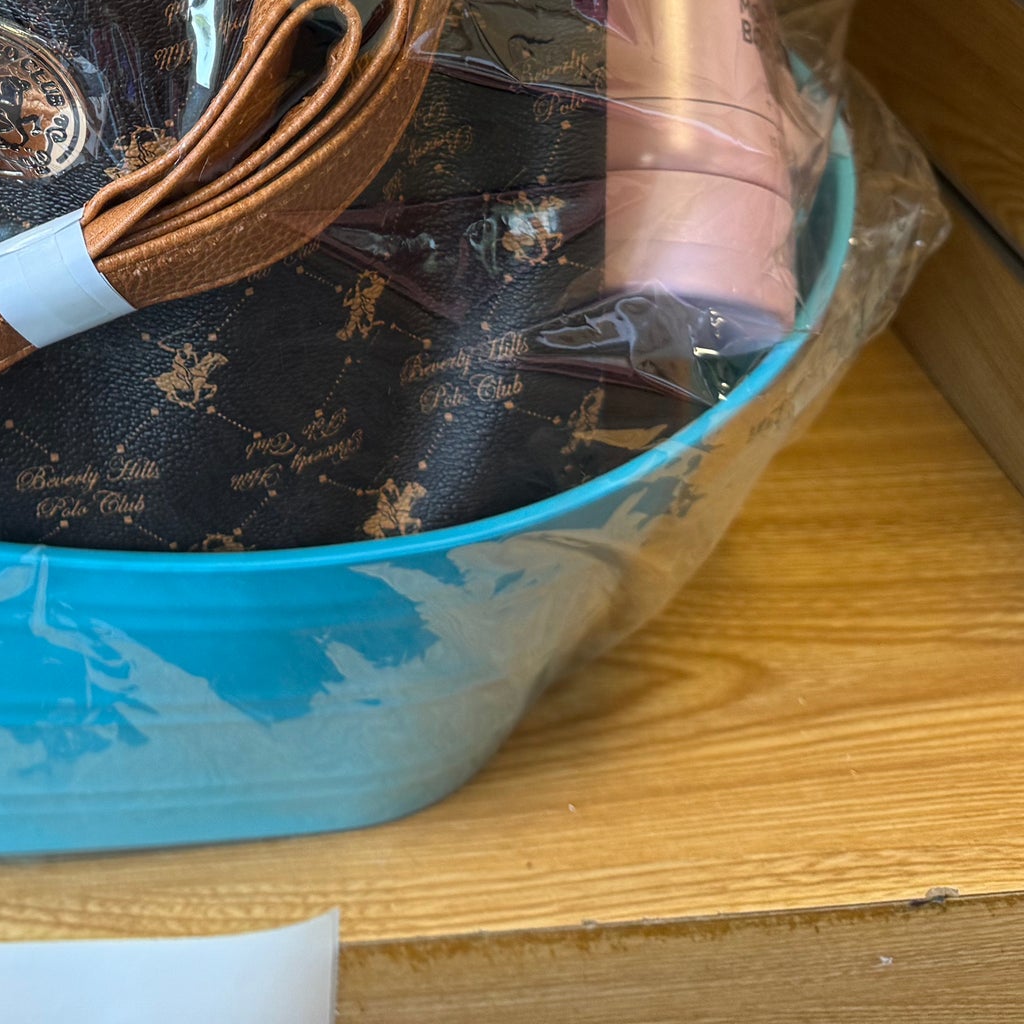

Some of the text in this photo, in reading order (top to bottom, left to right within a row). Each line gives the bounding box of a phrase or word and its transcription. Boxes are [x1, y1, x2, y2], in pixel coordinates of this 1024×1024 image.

[18, 53, 68, 109] CLUB
[469, 373, 524, 402] Club
[15, 455, 160, 493] Beverly Hills
[35, 488, 145, 519] Polo Club
